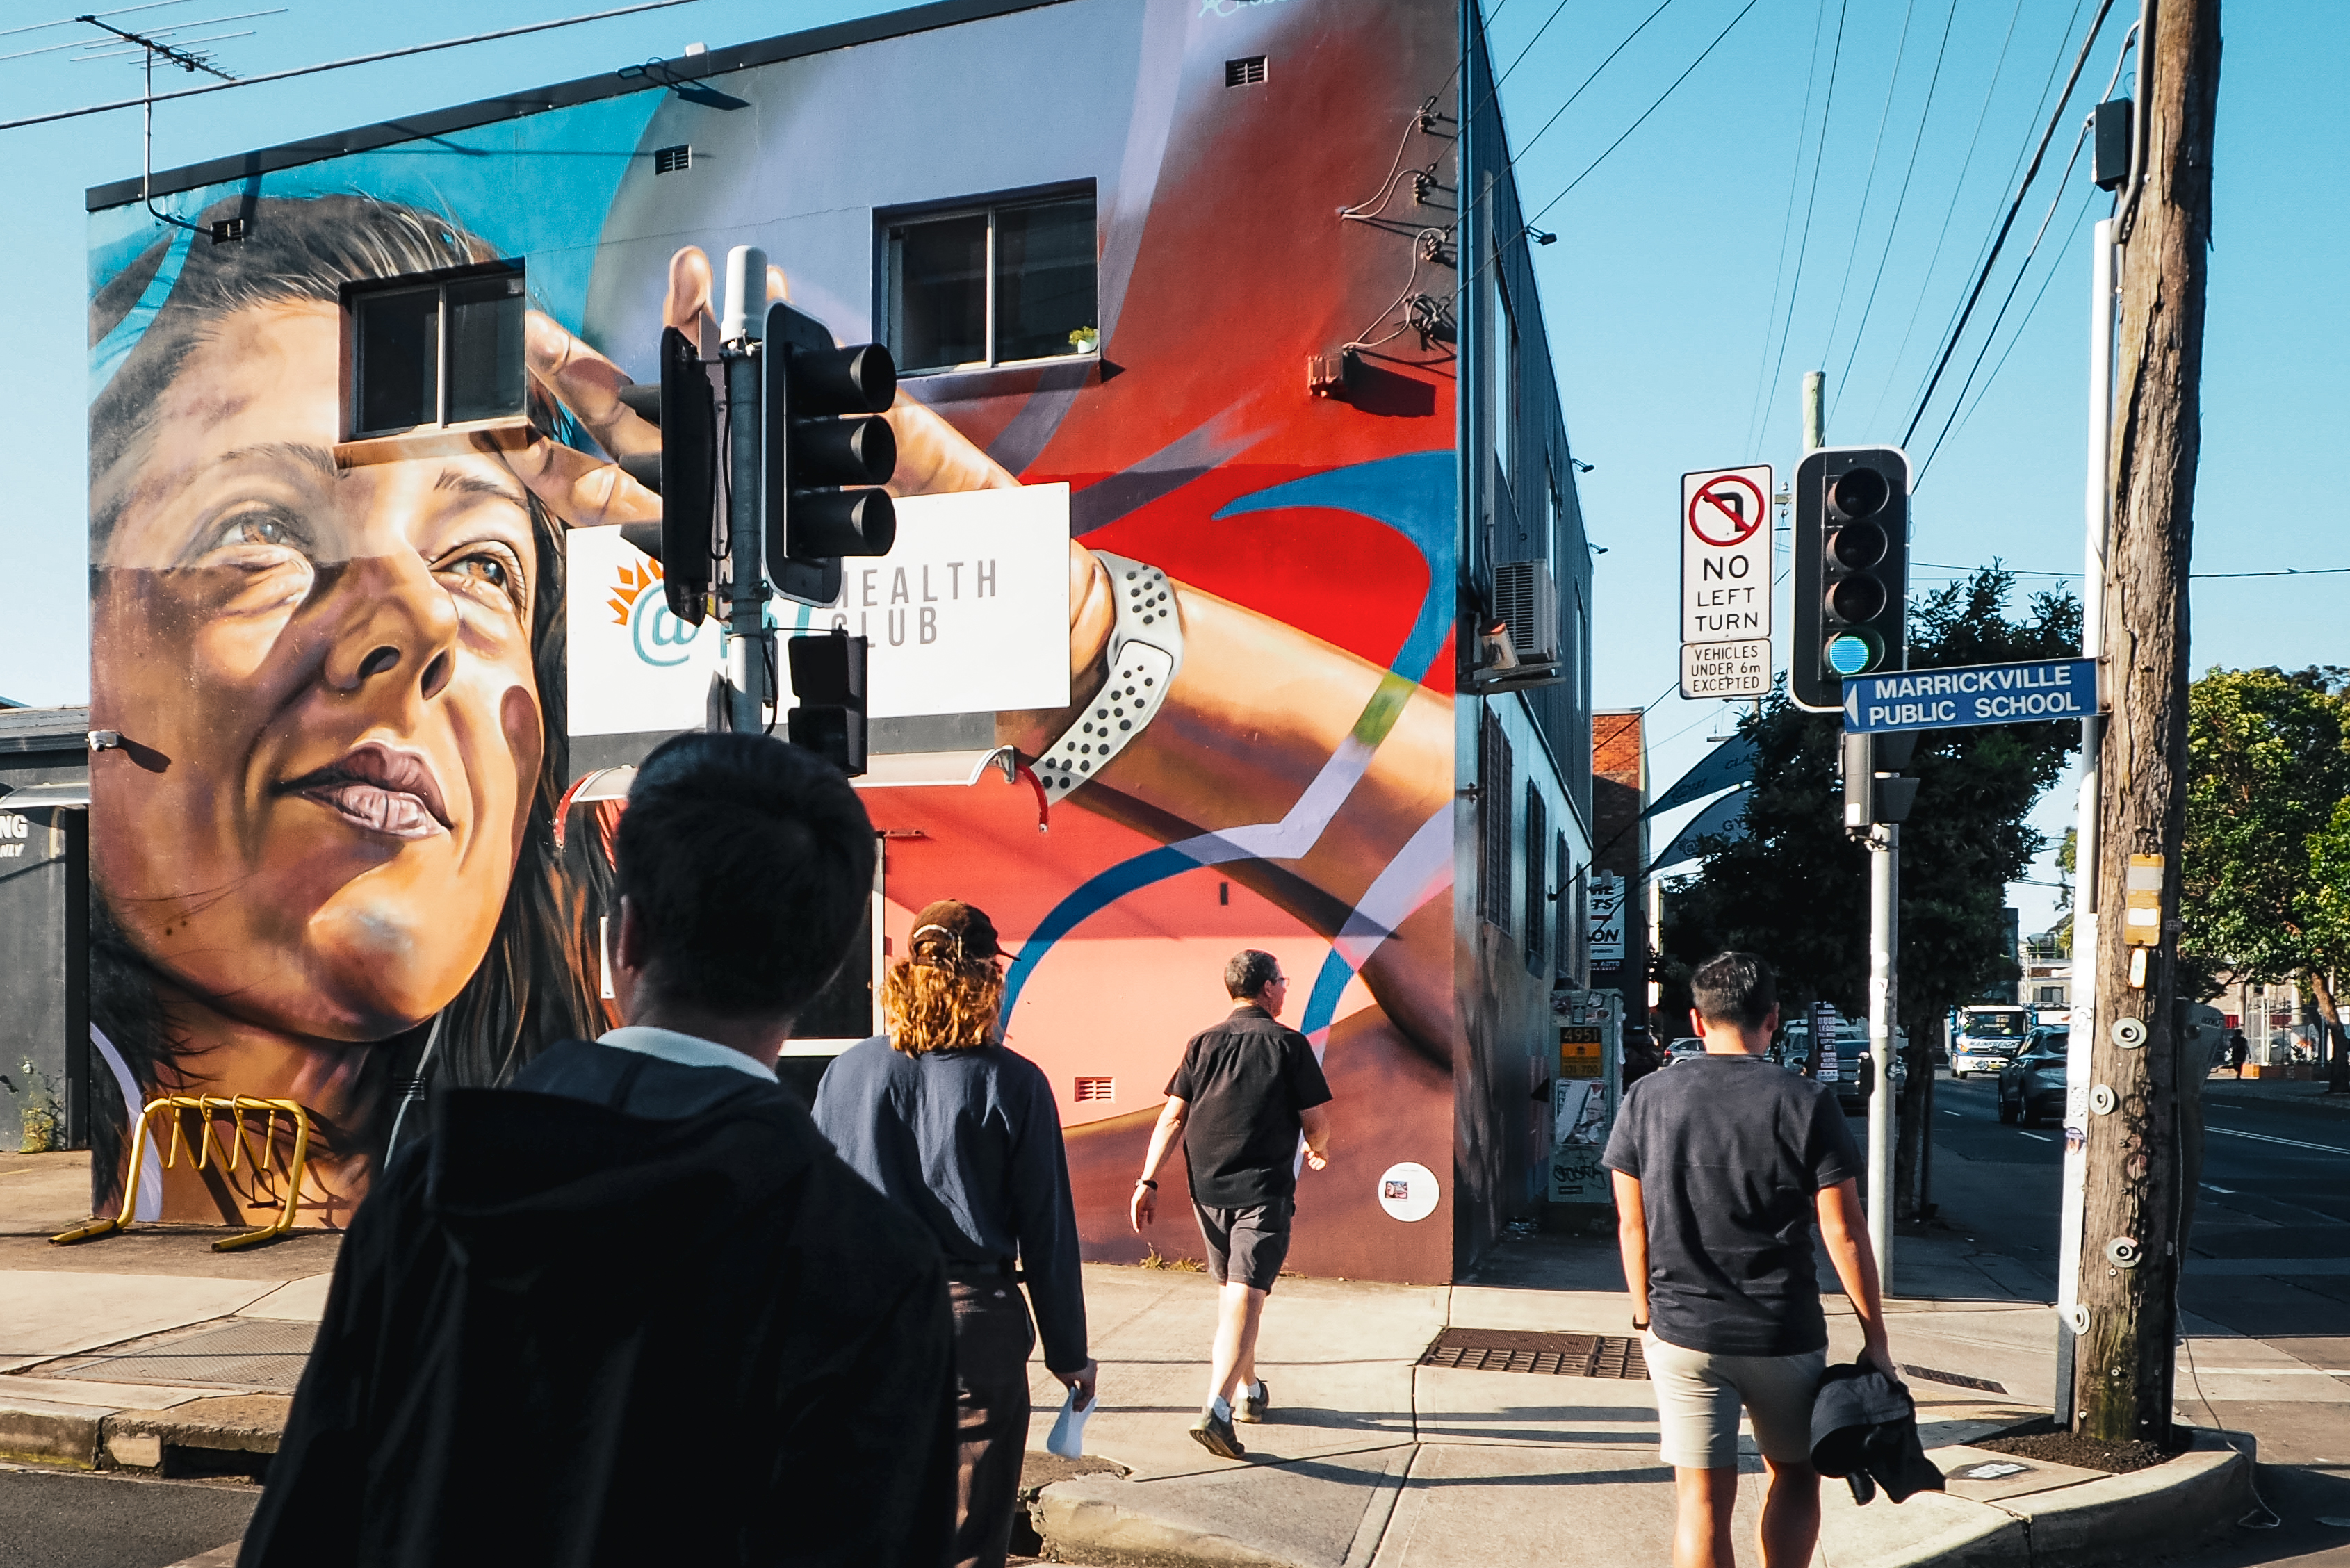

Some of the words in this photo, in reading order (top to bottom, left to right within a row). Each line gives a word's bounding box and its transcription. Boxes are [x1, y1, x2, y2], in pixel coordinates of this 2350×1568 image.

[1703, 555, 1749, 581] NO
[1697, 587, 1756, 607] LEFT
[1695, 612, 1759, 632] TURN
[1695, 645, 1759, 661] VEHICLES
[1691, 662, 1733, 677] UNDER
[1740, 662, 1761, 673] 6m
[1693, 676, 1759, 692] EXCEPTED
[1875, 665, 2072, 700] MARRICKVILLE
[1869, 700, 1956, 726] PUBLIC
[1975, 692, 2081, 719] SCHOOL
[1564, 1028, 1598, 1042] 4951
